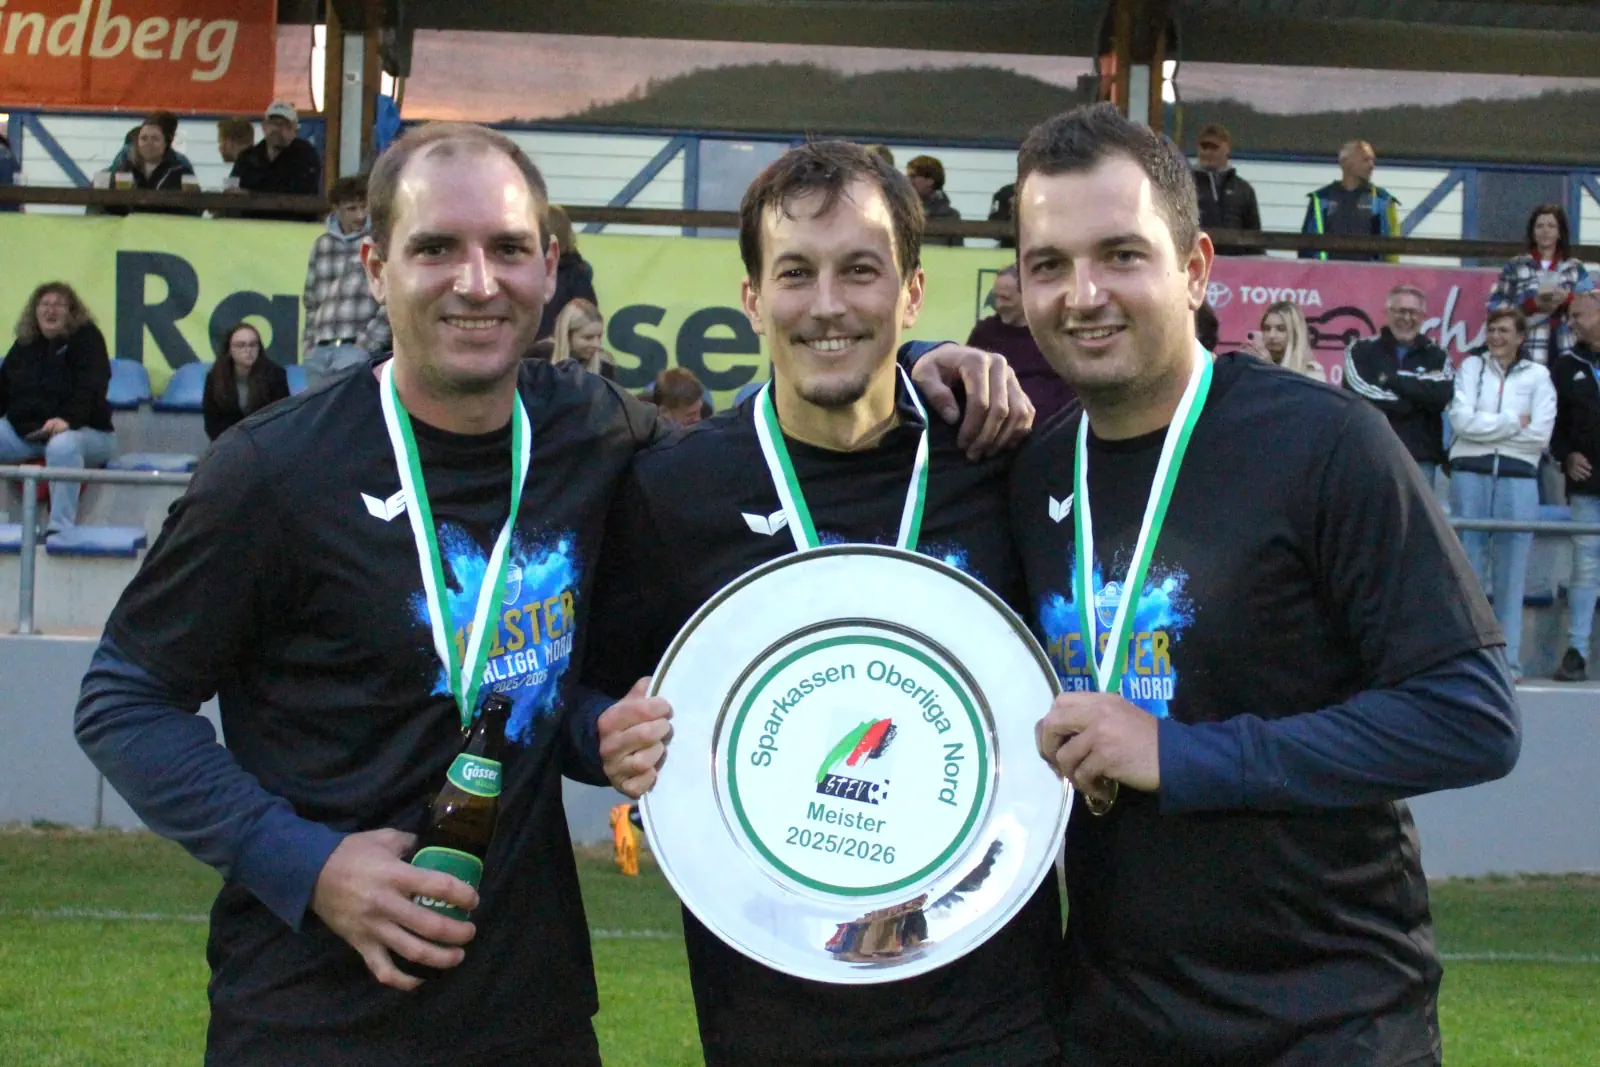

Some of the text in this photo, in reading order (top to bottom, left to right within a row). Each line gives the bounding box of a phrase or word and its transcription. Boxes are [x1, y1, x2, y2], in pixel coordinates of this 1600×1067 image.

[1240, 285, 1322, 307] TOYOTA
[544, 632, 573, 667] NORD
[1130, 675, 1173, 701] NORD
[750, 659, 965, 807] Sparkassen Oberliga Nord
[461, 761, 498, 782] Gösser
[824, 775, 868, 800] STFV
[806, 800, 887, 834] Meister
[785, 826, 896, 865] 2025/2026
